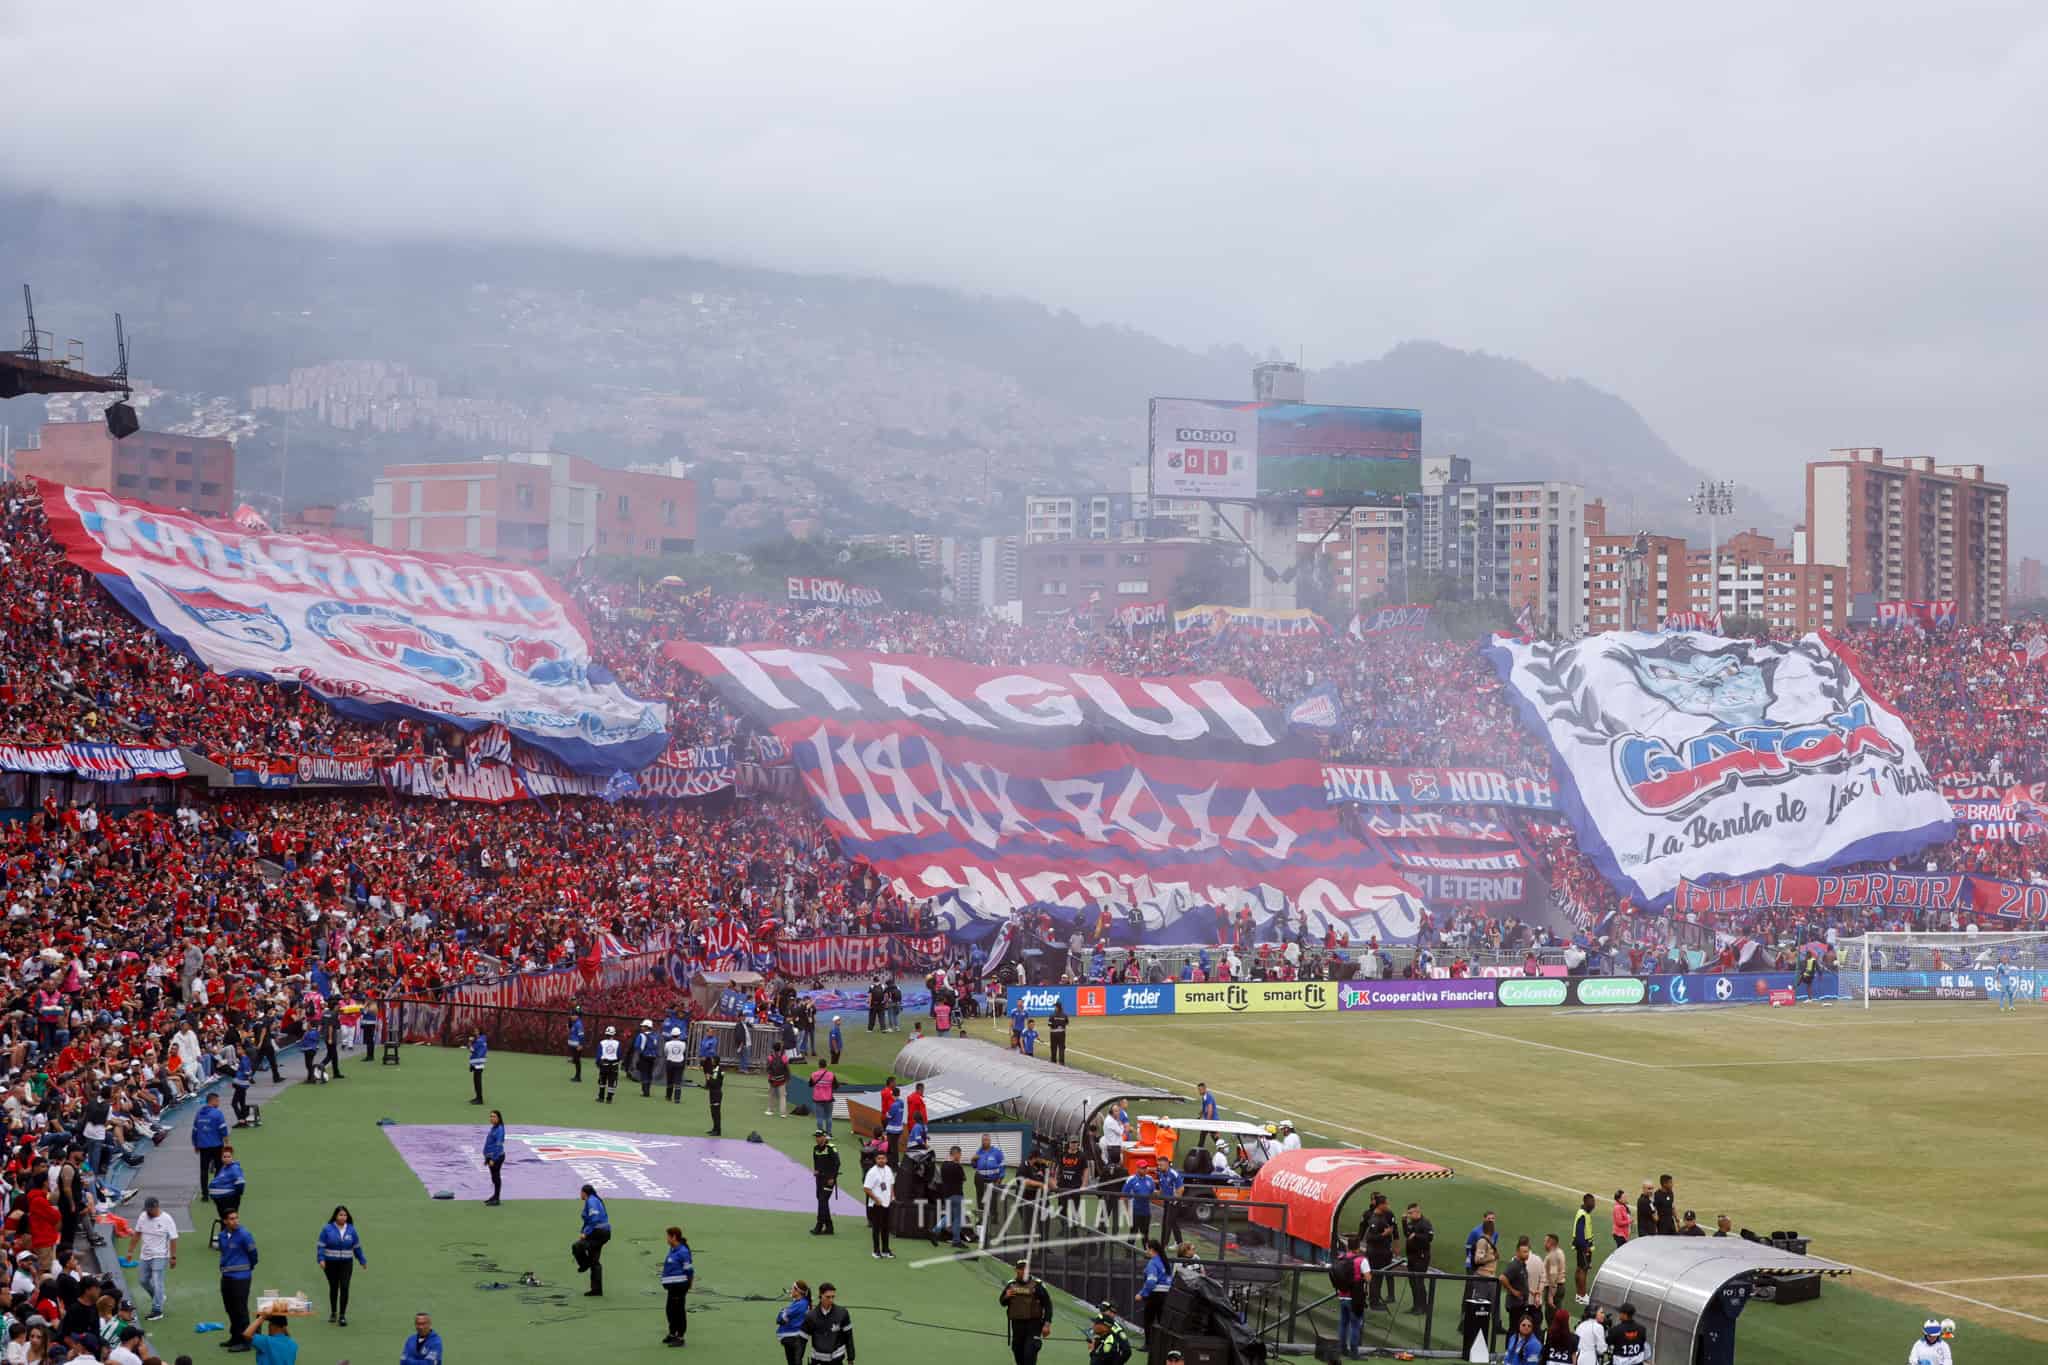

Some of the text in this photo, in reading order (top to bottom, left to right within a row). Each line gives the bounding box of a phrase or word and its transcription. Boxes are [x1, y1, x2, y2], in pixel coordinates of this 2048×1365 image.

[1180, 430, 1234, 443] 00:00
[704, 646, 1276, 747] ITAGUI
[312, 757, 341, 779] UNION
[1645, 832, 1684, 864] La
[1683, 802, 1772, 848] Banda
[1776, 792, 1807, 823] de
[1686, 872, 1792, 912] FILIAL
[1815, 872, 1974, 912] PEREIRA
[1185, 985, 1248, 1006] smart fit
[1264, 983, 1325, 1004] smart fit
[1372, 990, 1437, 1004] Cooperativa
[1441, 989, 1495, 1002] Financiera
[1271, 1169, 1329, 1201] GATORADE
[1622, 1344, 1640, 1355] 120
